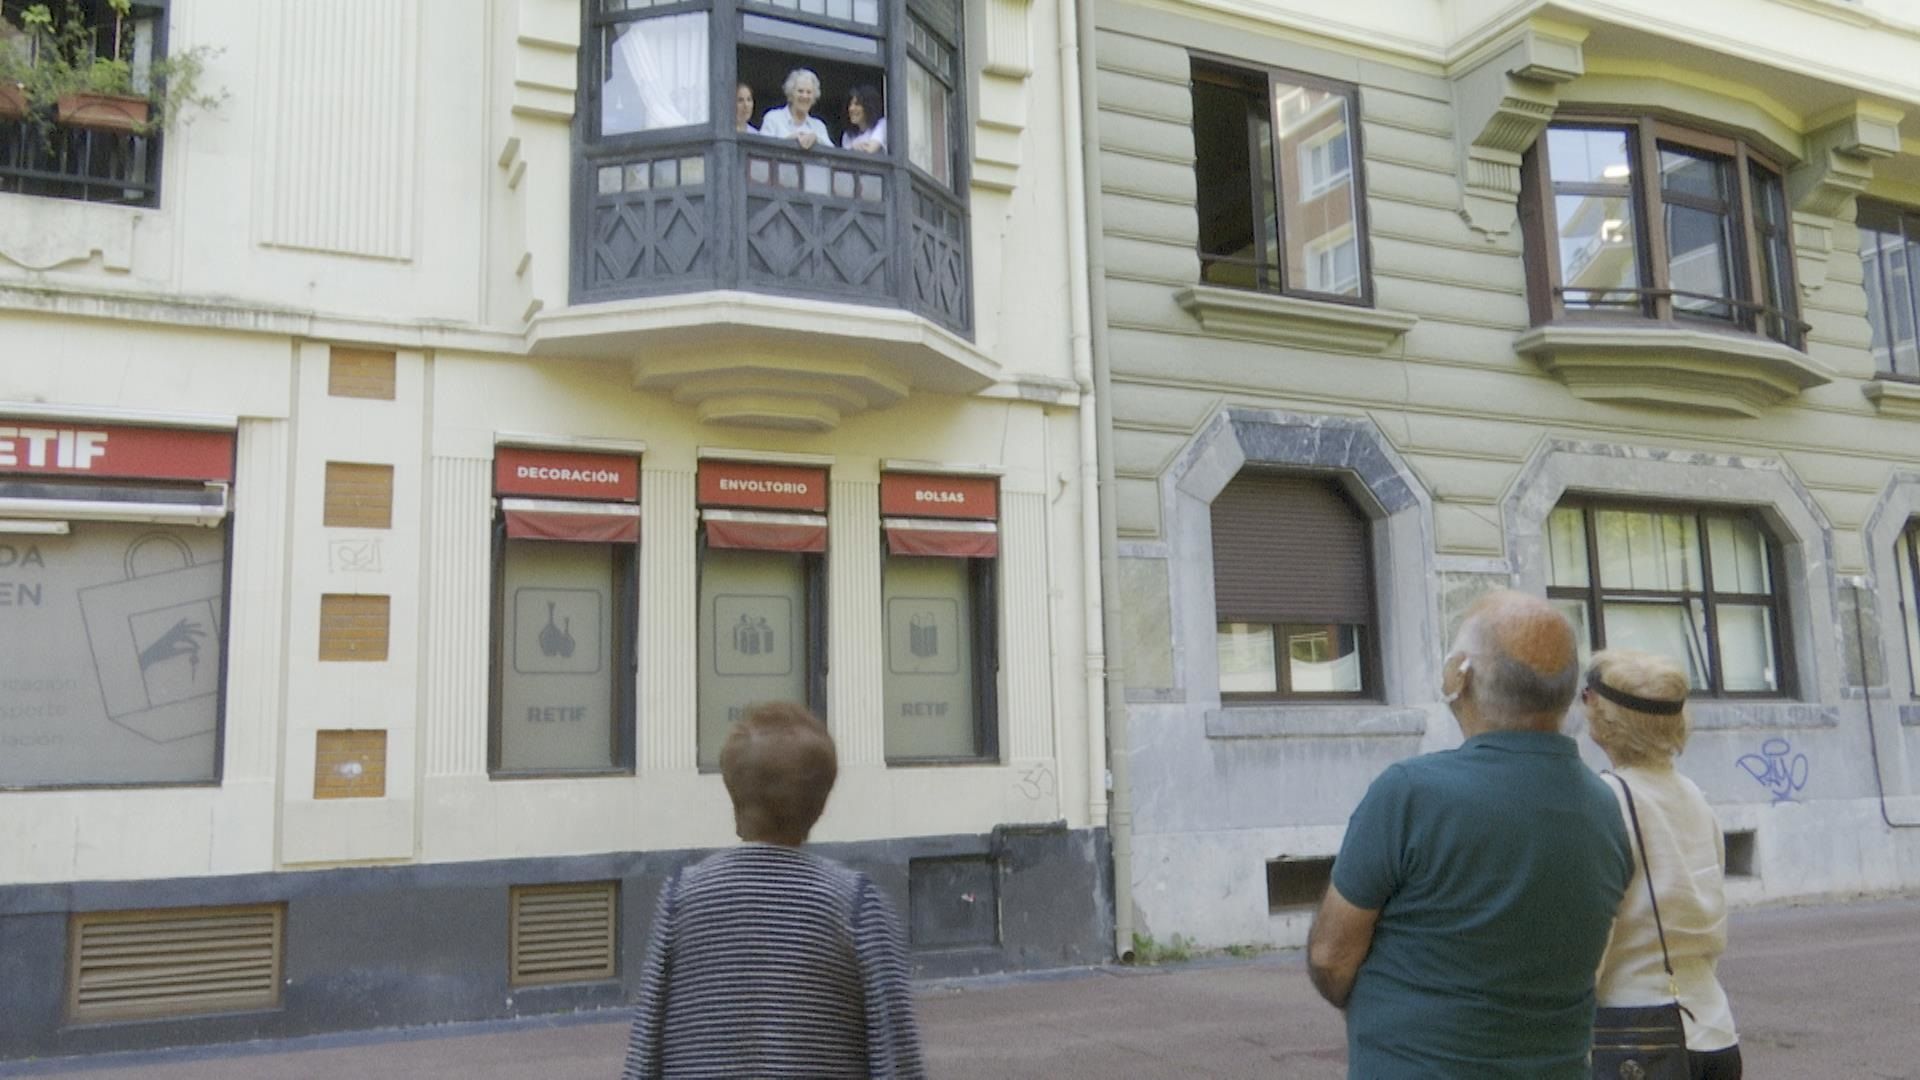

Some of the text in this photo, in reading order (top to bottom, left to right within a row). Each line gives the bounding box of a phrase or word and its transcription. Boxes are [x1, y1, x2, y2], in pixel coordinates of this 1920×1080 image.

[517, 466, 619, 483] DECORACIÓN
[719, 479, 807, 494] ENVOLTORIO
[915, 490, 965, 503] BOLSAS
[527, 706, 587, 722] RETIF
[901, 702, 949, 717] RETIF
